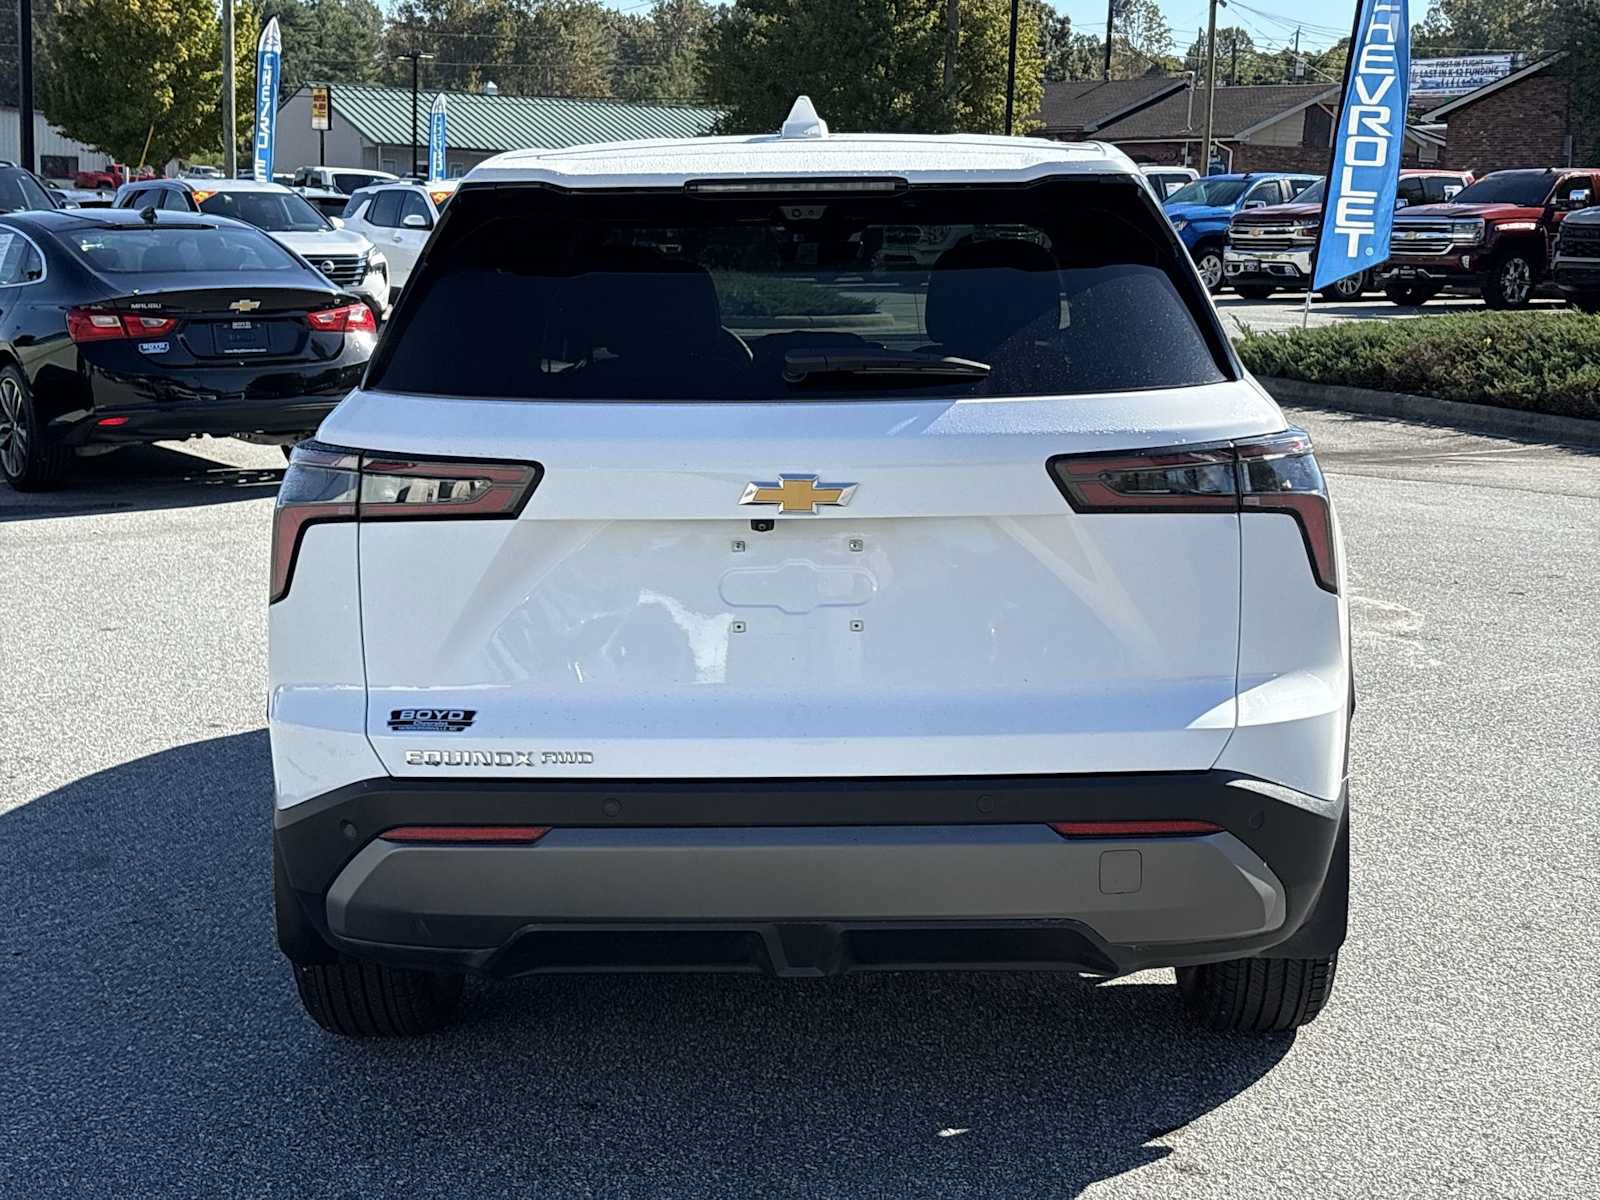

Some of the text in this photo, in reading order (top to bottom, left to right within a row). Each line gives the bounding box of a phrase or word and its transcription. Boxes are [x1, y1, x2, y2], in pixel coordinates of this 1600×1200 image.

[399, 710, 465, 720] BOYD
[405, 750, 594, 767] EQUINOX AWD
